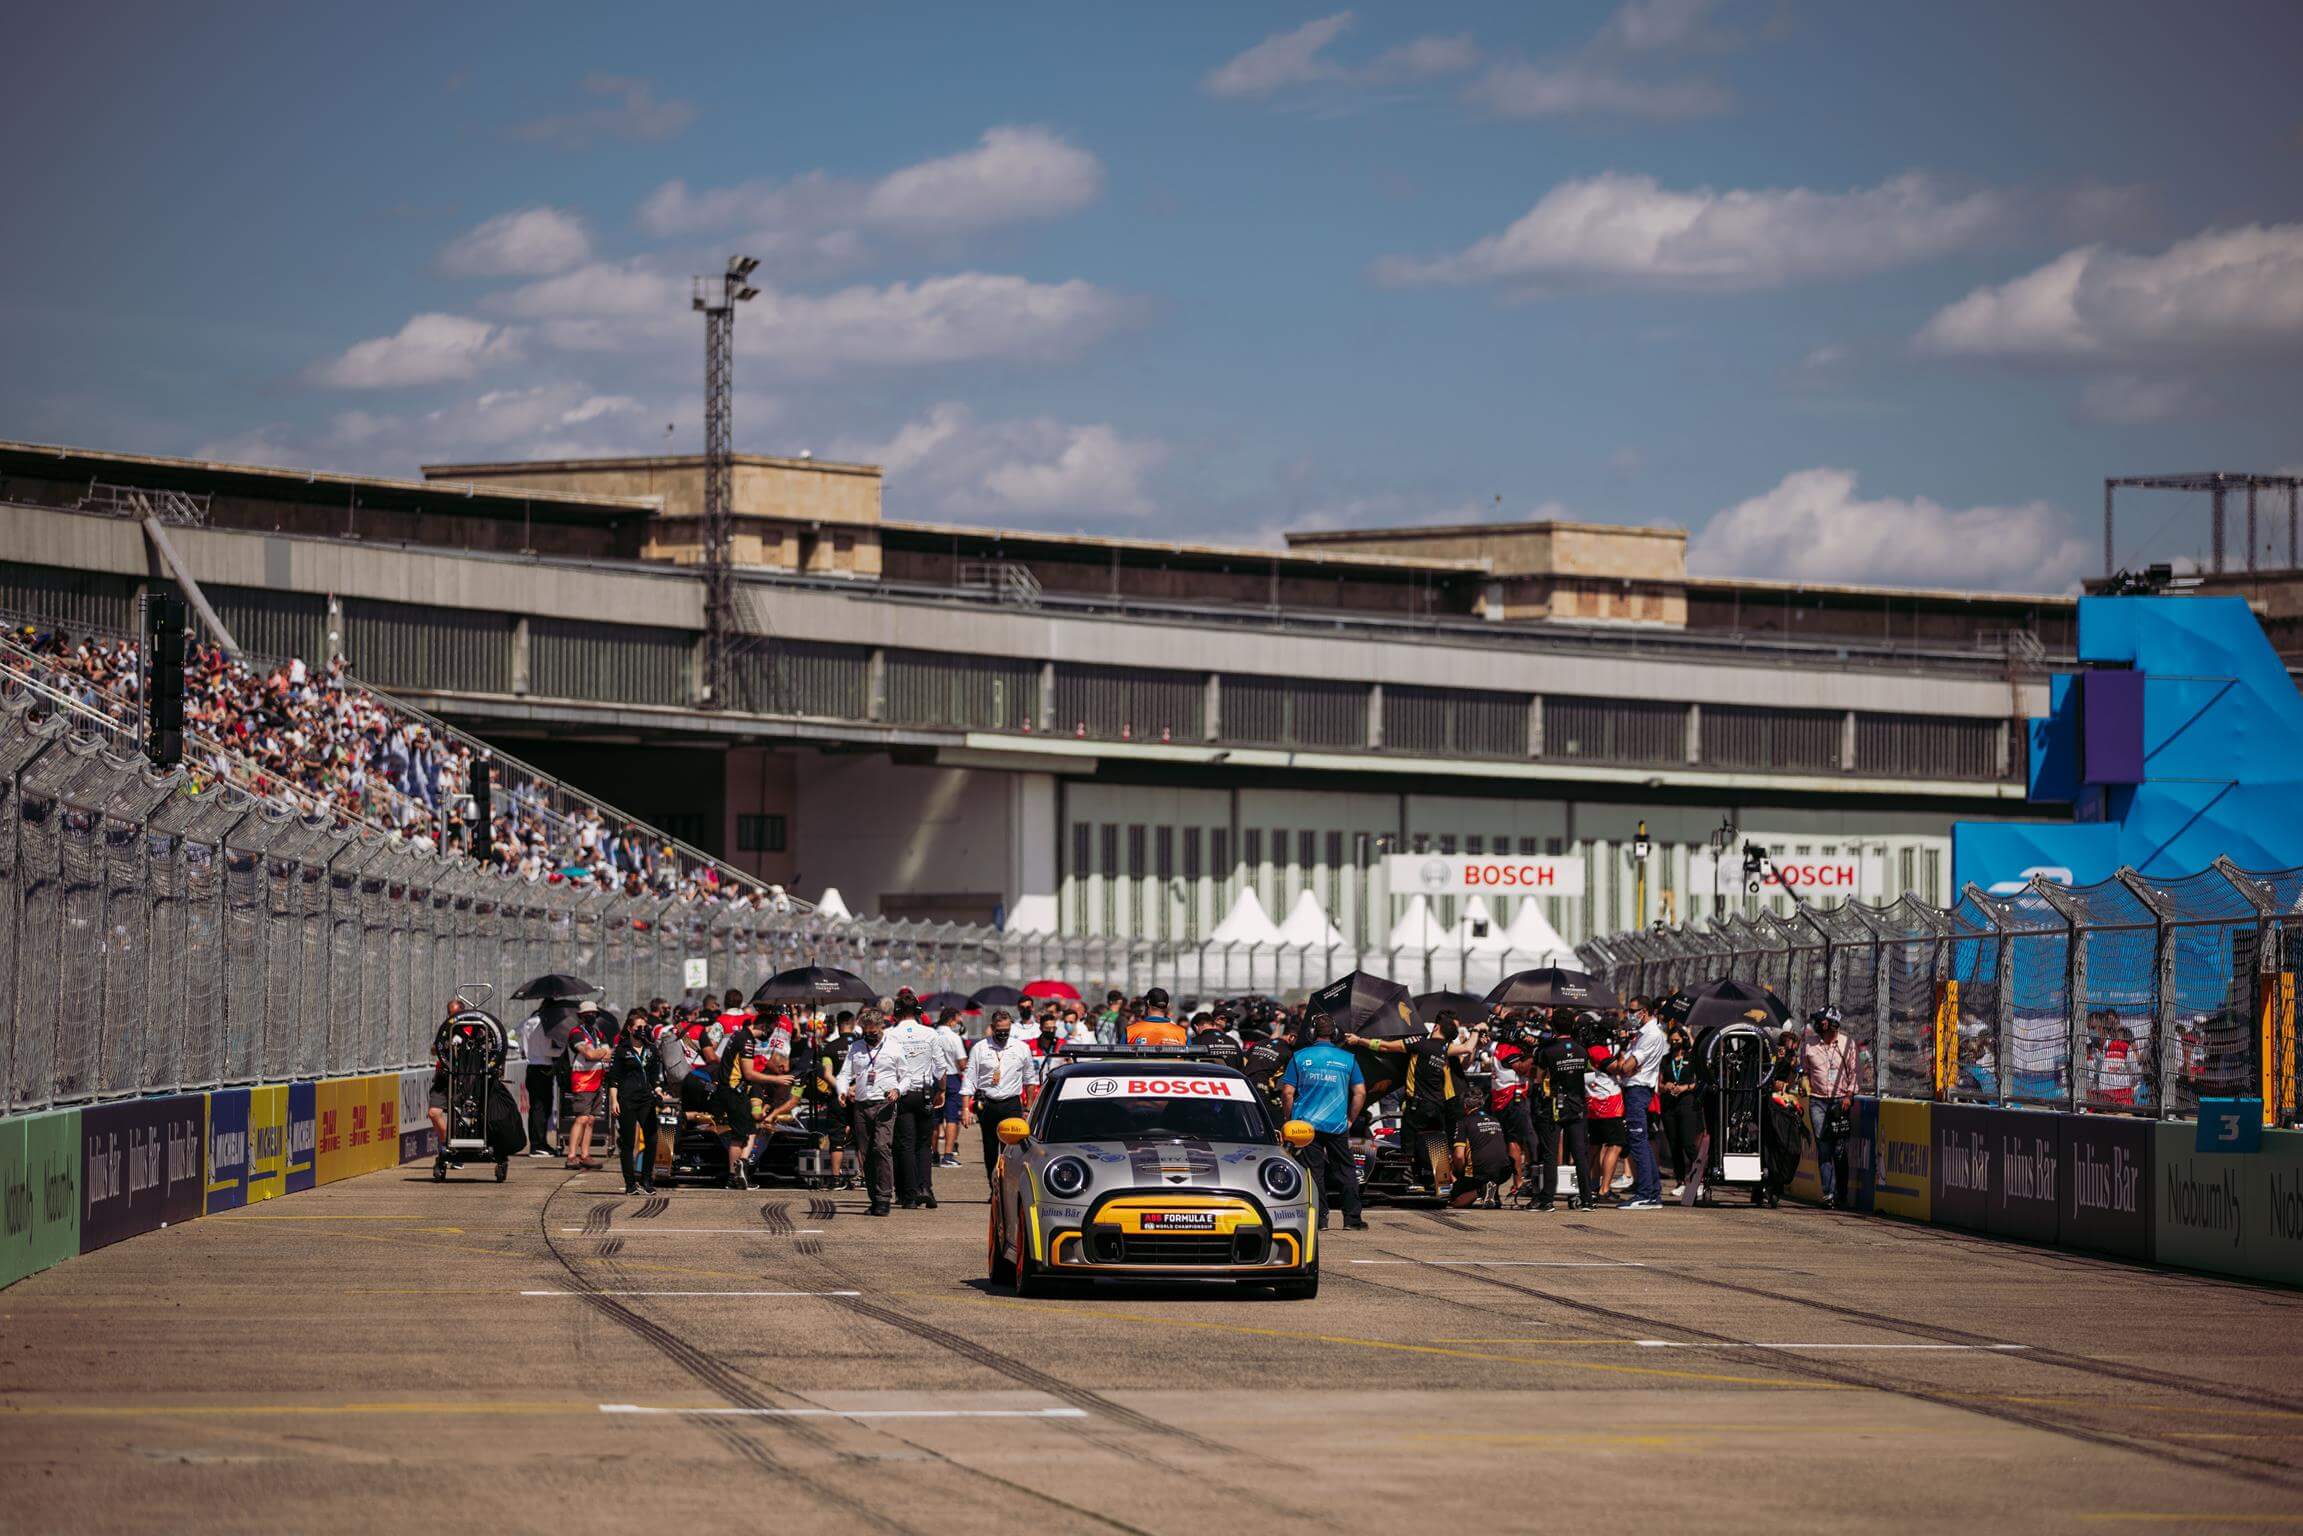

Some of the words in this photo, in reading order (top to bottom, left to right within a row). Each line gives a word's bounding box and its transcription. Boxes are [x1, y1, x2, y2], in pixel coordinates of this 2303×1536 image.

[1464, 864, 1554, 887] BOSCH
[1127, 1079, 1232, 1097] BOSCH
[1310, 1072, 1321, 1081] PIT
[1321, 1073, 1337, 1083] LANE
[2218, 1114, 2241, 1141] 3
[1887, 1141, 1930, 1178] MICHELIN
[1942, 1128, 1969, 1199] Julius
[1971, 1132, 1991, 1192] Bär
[2003, 1135, 2035, 1209] Julius
[2036, 1138, 2057, 1201] Bär
[2073, 1141, 2110, 1220] Julius
[2113, 1146, 2139, 1213] Bär
[1041, 1207, 1063, 1218] Julius
[1065, 1207, 1081, 1218] Bär
[1144, 1214, 1162, 1222] ABB
[1163, 1214, 1206, 1223] FORMULA
[1206, 1214, 1213, 1223] E
[1274, 1210, 1296, 1220] Julius
